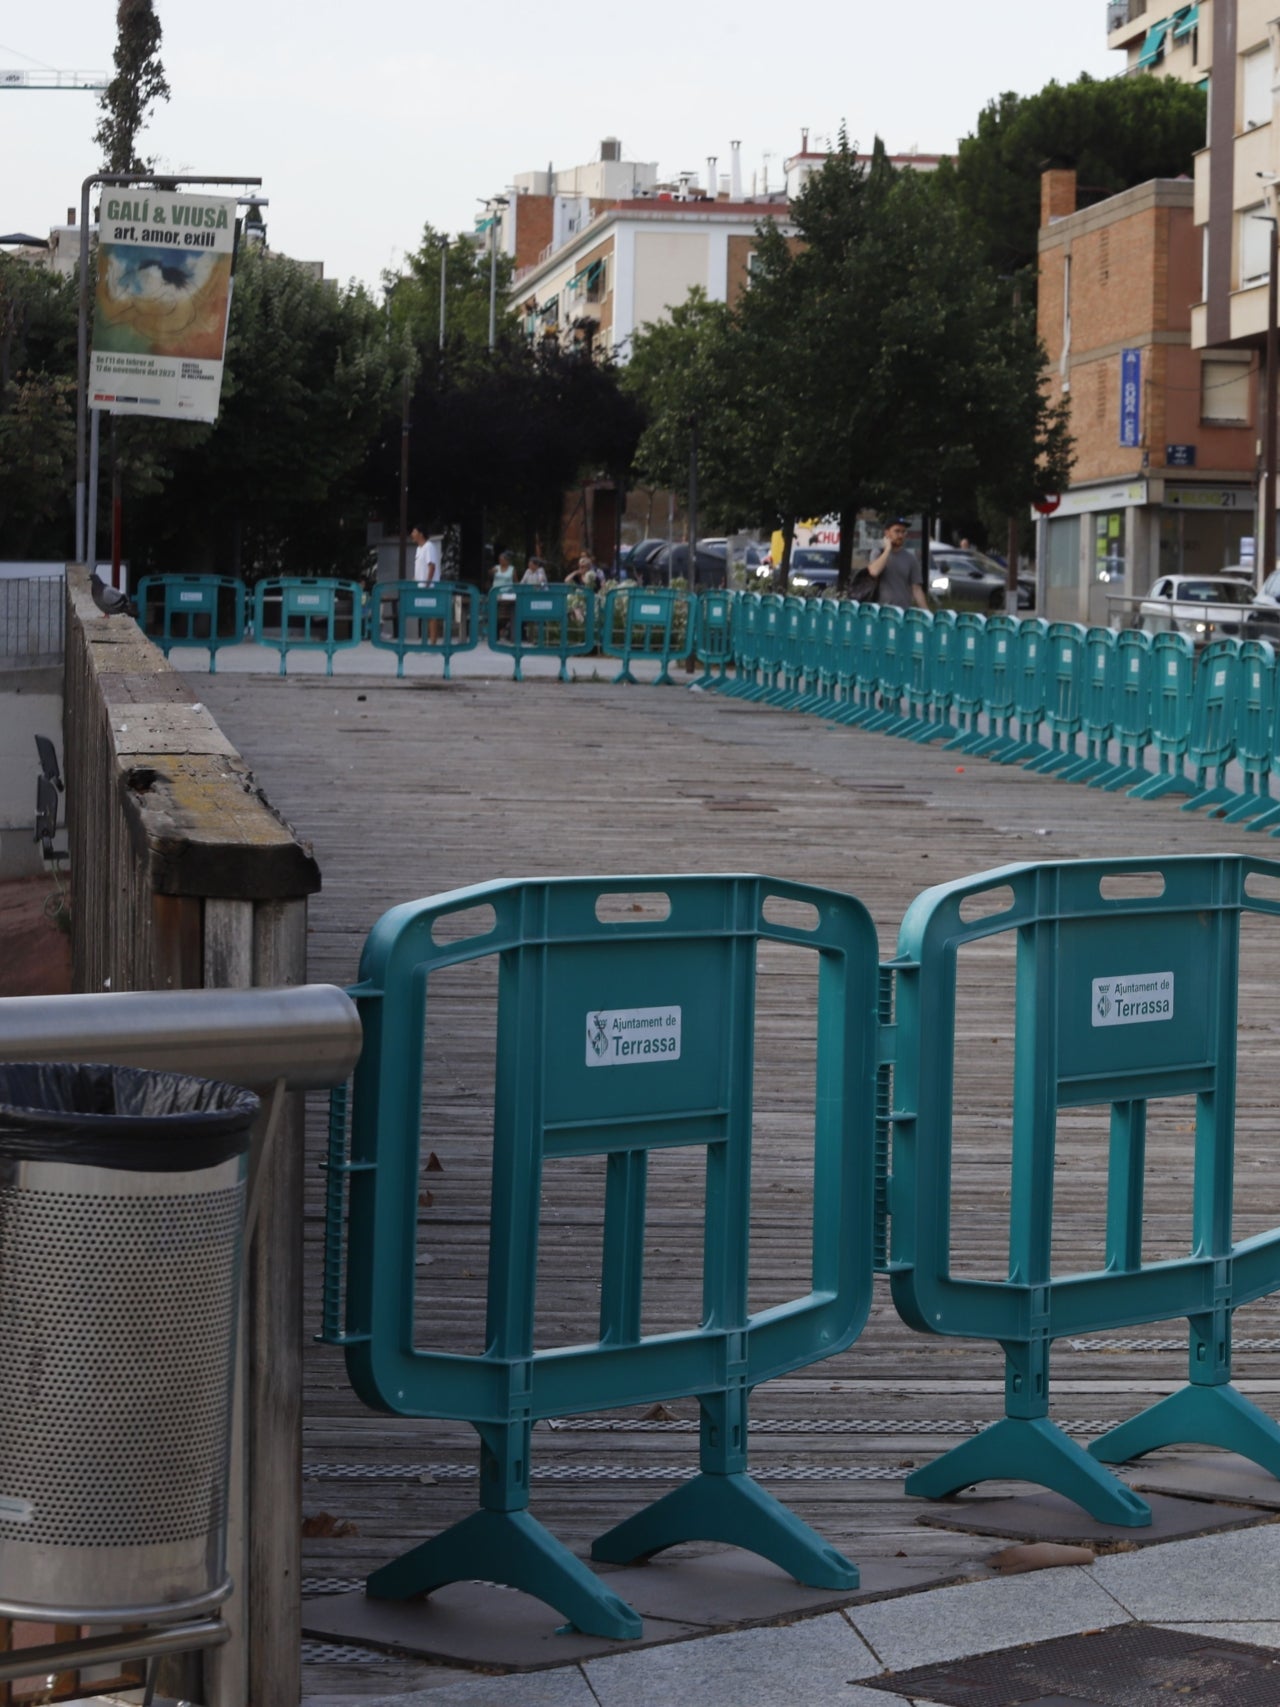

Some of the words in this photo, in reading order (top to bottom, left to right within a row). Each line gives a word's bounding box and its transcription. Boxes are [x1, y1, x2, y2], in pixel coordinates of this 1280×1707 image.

[107, 198, 150, 222] GALÍ
[152, 206, 166, 224] &
[171, 204, 229, 229] VIUSÀ
[114, 226, 138, 242] art,
[141, 228, 180, 246] amor,
[184, 231, 216, 247] exili
[1114, 981, 1158, 995] Ajuntament
[1160, 979, 1170, 990] de
[1115, 999, 1170, 1017] Terrassa
[612, 1016, 662, 1032] Ajuntament
[665, 1014, 677, 1026] de
[612, 1036, 676, 1057] Terrassa
